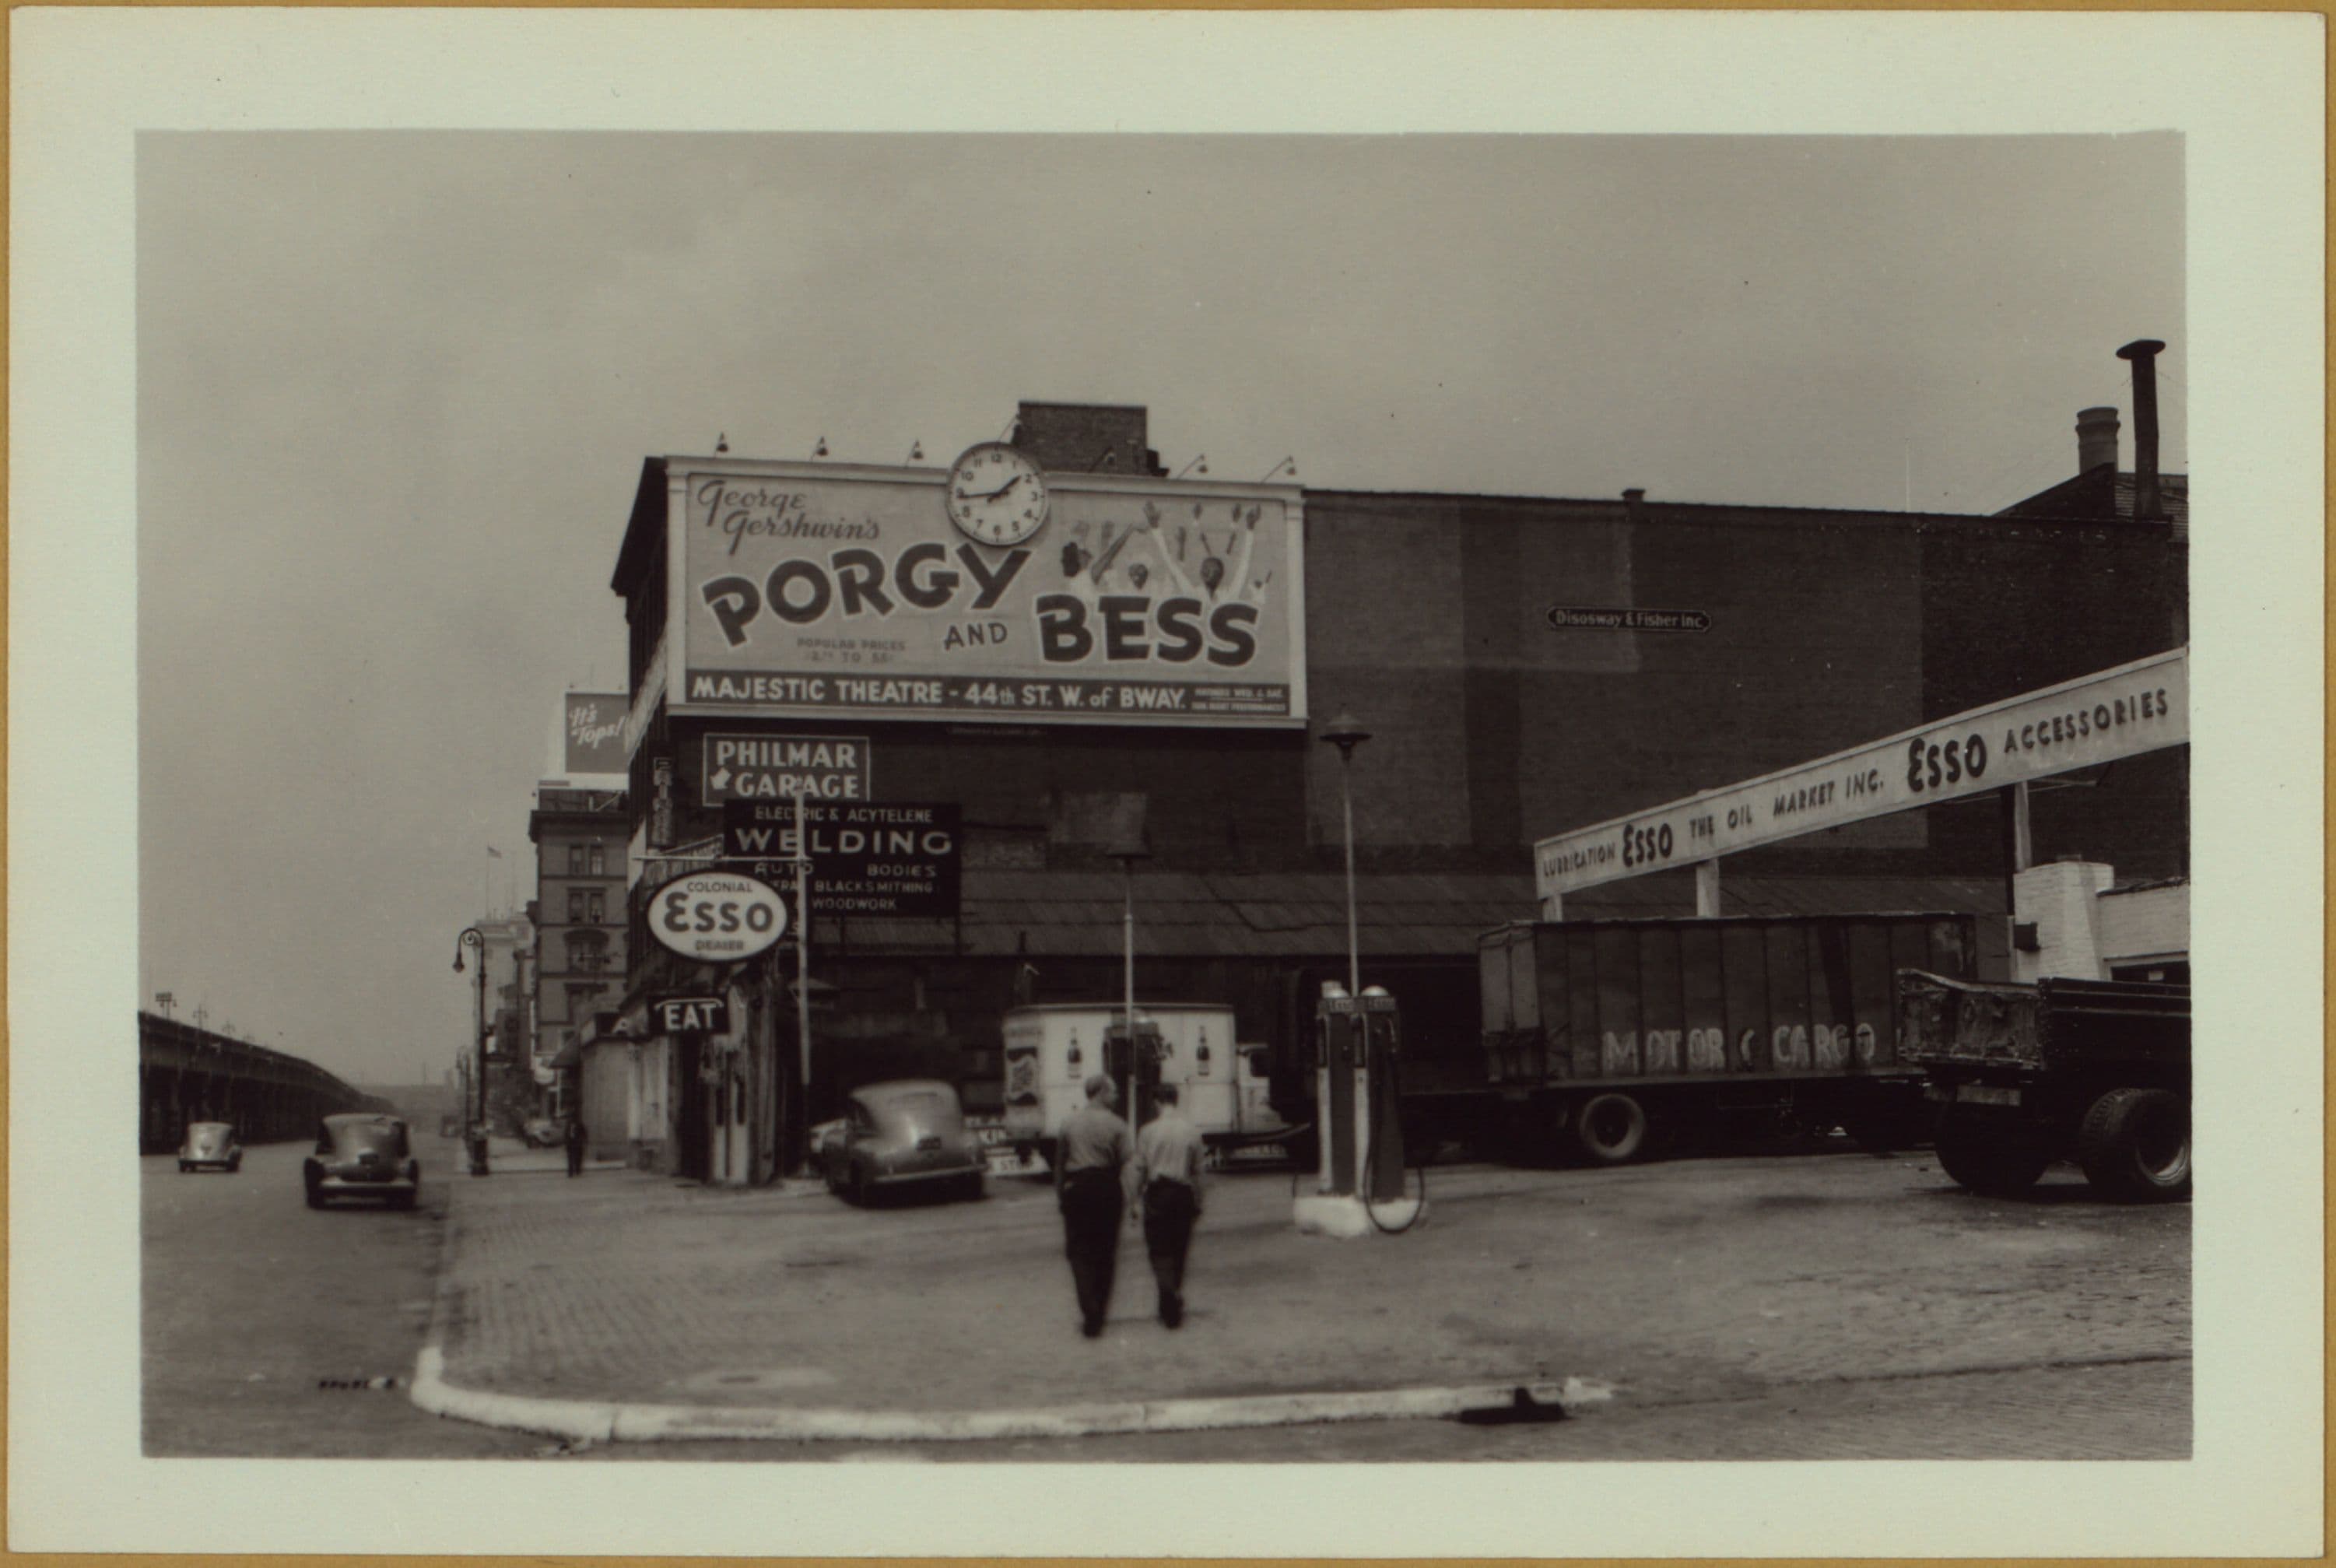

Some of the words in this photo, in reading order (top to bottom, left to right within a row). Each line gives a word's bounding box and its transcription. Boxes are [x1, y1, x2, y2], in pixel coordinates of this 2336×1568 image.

[973, 459, 982, 468] 11
[991, 454, 1002, 463] 12
[961, 471, 974, 481] 10
[1026, 473, 1032, 483] 2
[697, 479, 808, 527] George
[1032, 491, 1037, 502] 3
[963, 506, 971, 517] 8
[1024, 510, 1032, 519] 4
[976, 518, 984, 528] 7
[993, 524, 1001, 535] 6
[1012, 521, 1020, 531] 5
[723, 510, 881, 556] Gershwin's
[703, 543, 1033, 647] PORGY
[1556, 610, 1622, 629] Disosway
[1636, 613, 1678, 627] Fisher
[1681, 614, 1703, 629] Inc
[944, 623, 1008, 651] AND
[1036, 594, 1259, 668] BESS
[797, 637, 856, 649] POPULAR
[861, 640, 907, 651] PRICES
[693, 676, 826, 700] MAJESTIC
[835, 679, 942, 703] THEATRE
[964, 682, 1015, 707] 44th
[1022, 686, 1054, 707] ST.
[1059, 688, 1084, 708] W.
[1090, 689, 1113, 709] of
[1119, 688, 1187, 710] BWAY.
[569, 703, 598, 727] It's
[571, 715, 626, 749] Tops!
[716, 740, 857, 768] PHILMAR
[735, 772, 860, 798] GARAGE
[1543, 840, 1616, 879] LUBRICATION
[1622, 824, 1673, 868] ESSO
[1689, 816, 1714, 839] THE
[1727, 805, 1752, 830] OIL
[1773, 780, 1835, 817] MARKET
[1846, 769, 1885, 799] INC.
[1907, 734, 1987, 792] ESSO
[2004, 689, 2169, 753] ACCESSORIES
[755, 806, 824, 822] ELECTRIC
[830, 808, 839, 821] &
[847, 809, 934, 824] ACYTELENE
[735, 827, 952, 855] WELDING
[754, 863, 815, 876] AUTO
[867, 864, 938, 878] BODIES
[687, 882, 754, 892] COLONIAL
[814, 879, 934, 893] BLACKSMITHING
[664, 891, 773, 932] ESSO
[812, 898, 896, 910] WOODWORK
[696, 939, 745, 951] DEALER
[664, 1003, 717, 1031] EAT
[1601, 1026, 1725, 1074] MOTOR
[1773, 1023, 1876, 1071] CARGO
